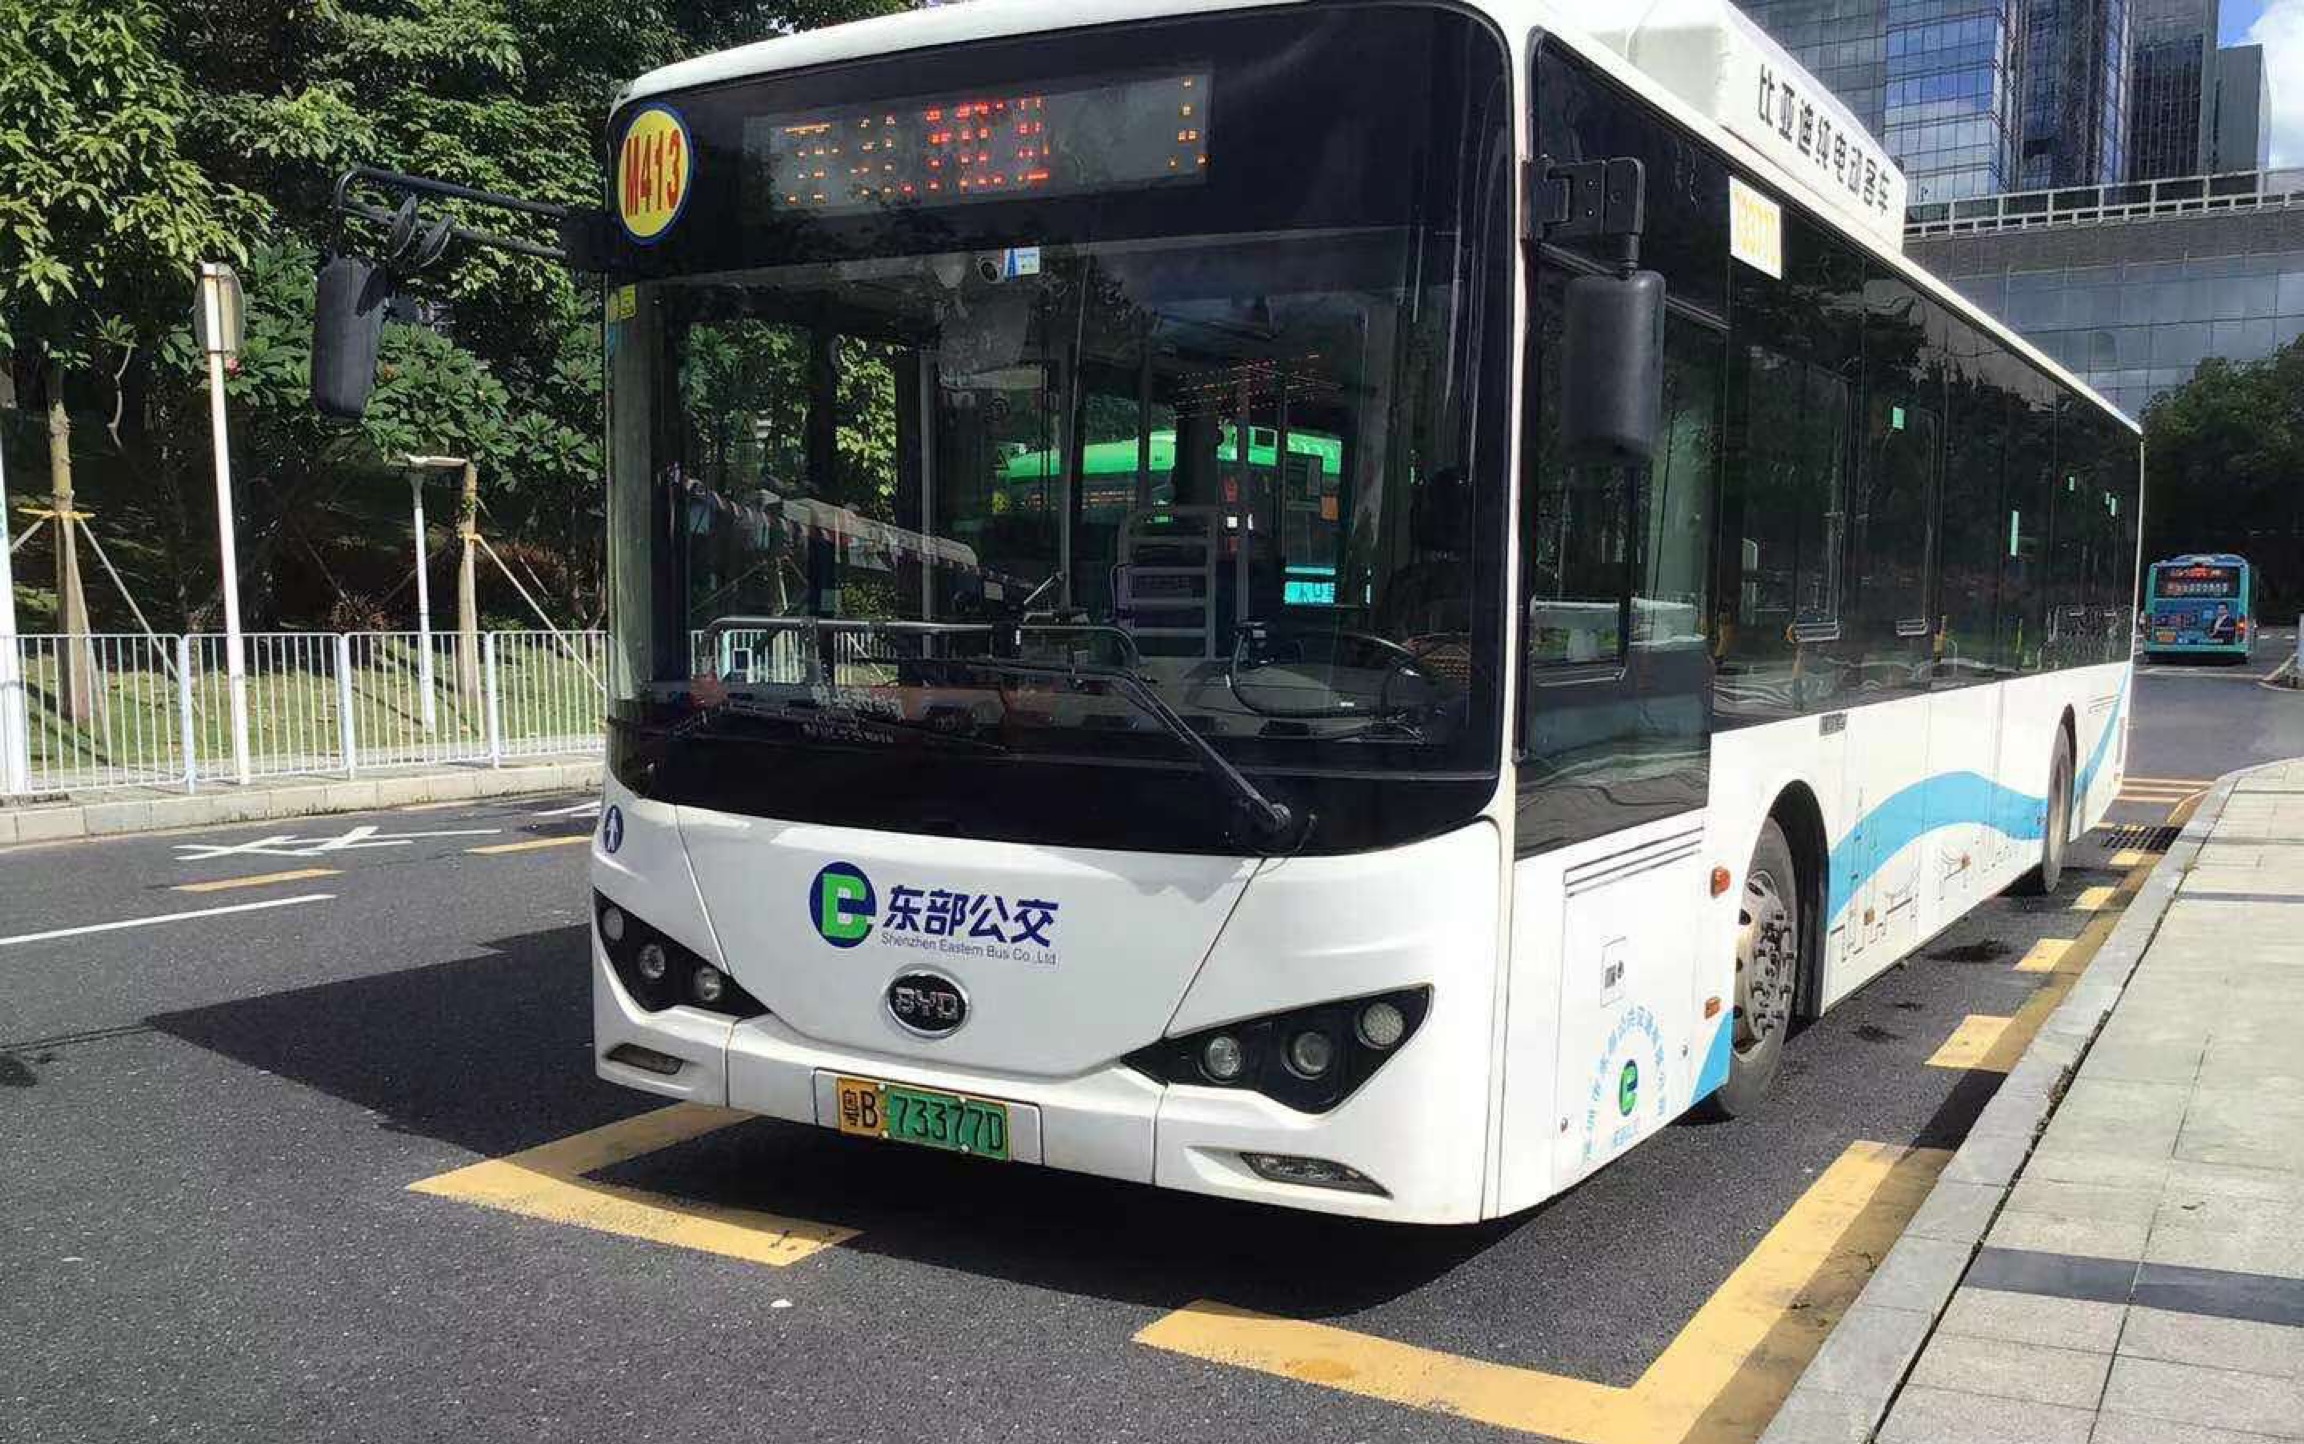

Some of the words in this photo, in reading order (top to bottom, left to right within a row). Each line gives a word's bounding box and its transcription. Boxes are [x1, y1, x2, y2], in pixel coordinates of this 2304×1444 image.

[625, 128, 682, 218] M413
[883, 884, 1060, 948] 东部公交
[881, 931, 937, 950] Shenzhen
[986, 945, 1010, 960] Bus
[895, 986, 959, 1020] BYD
